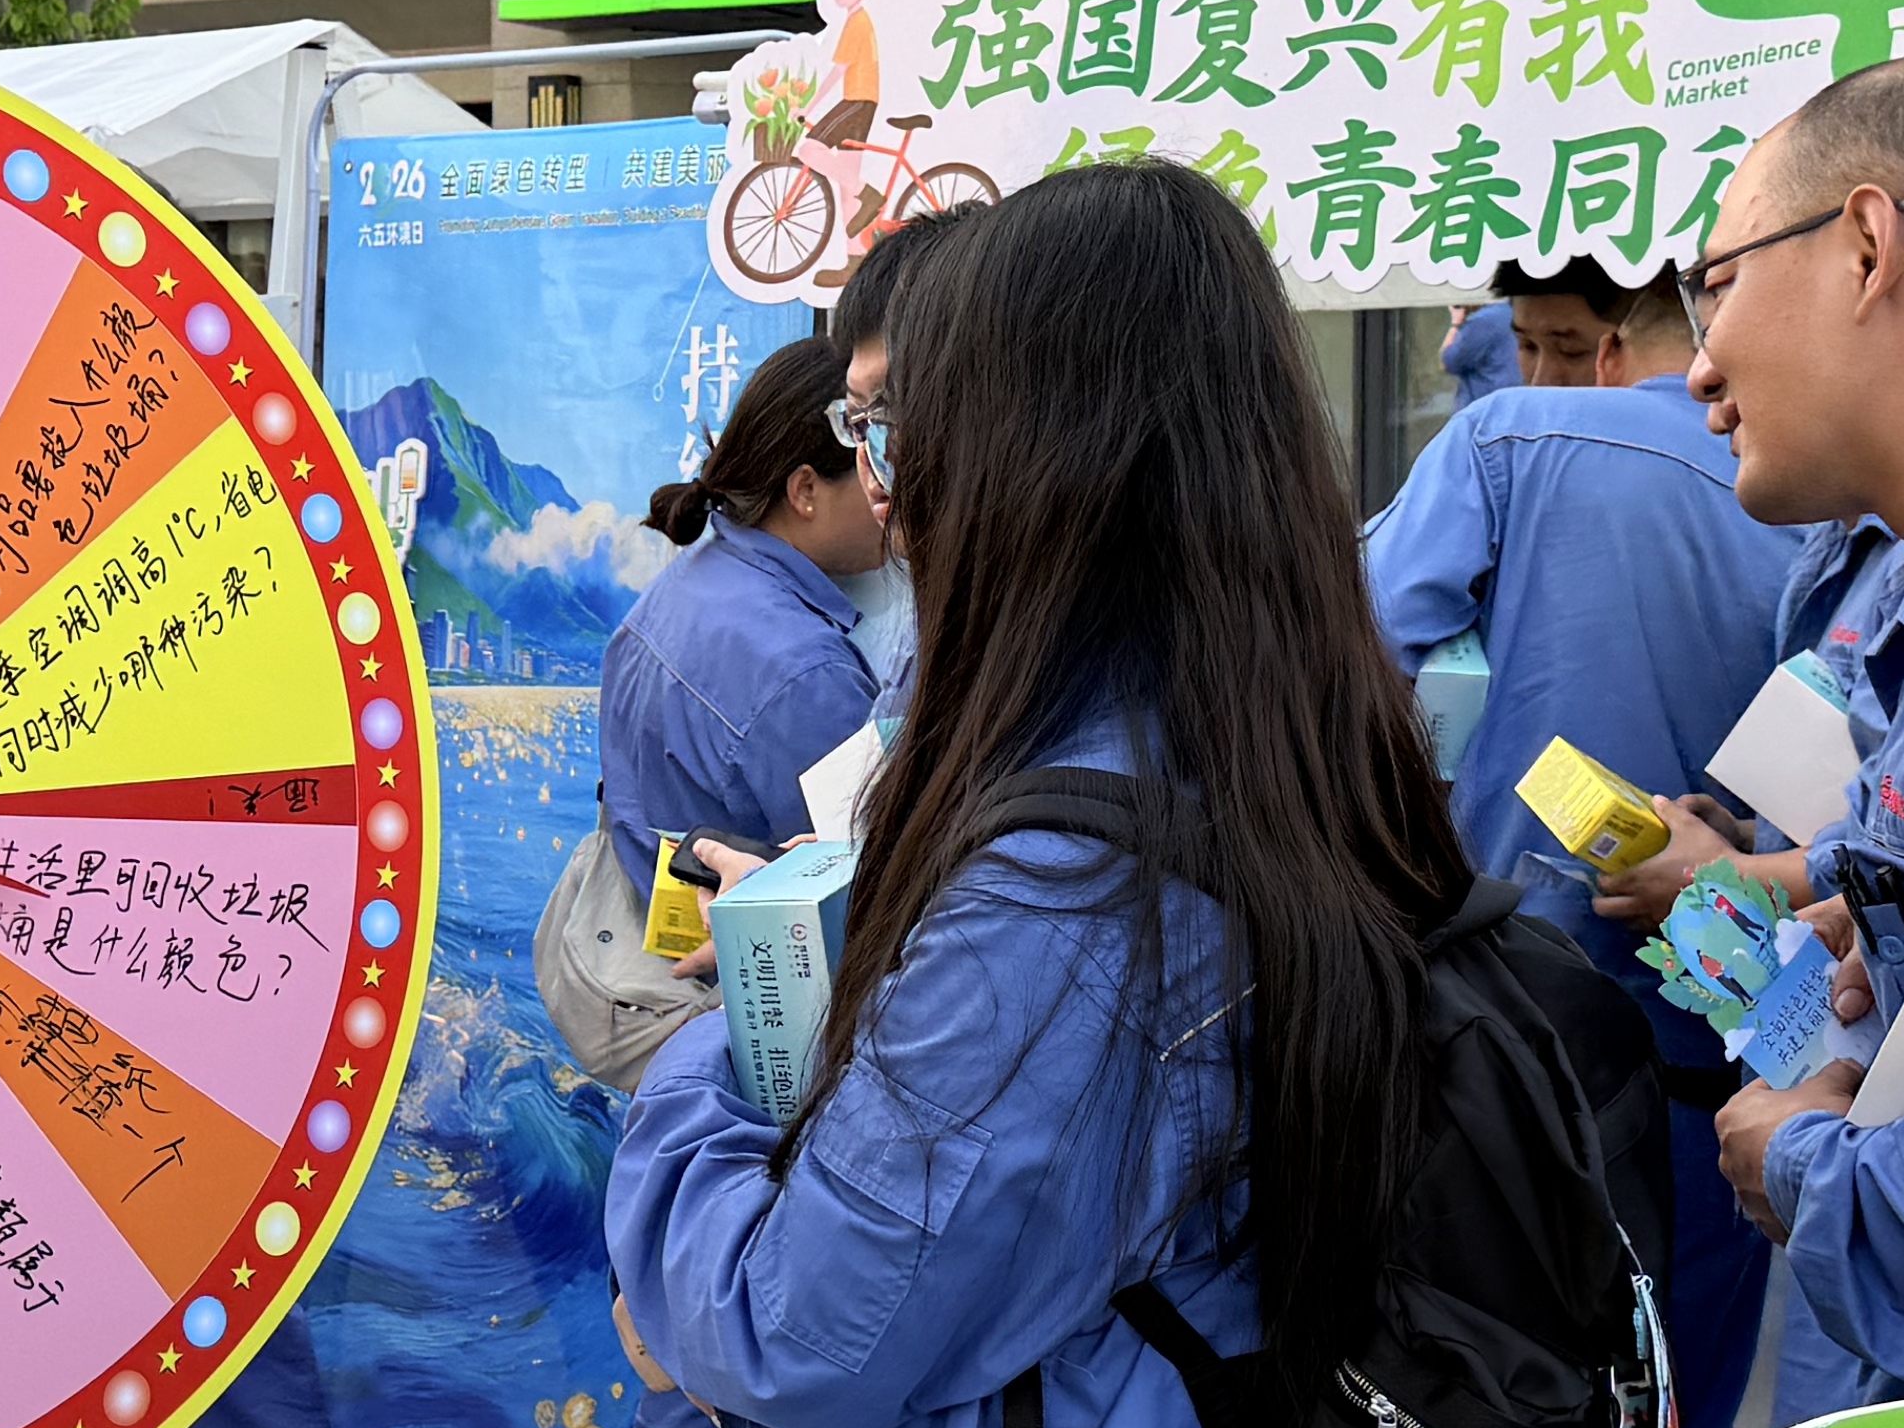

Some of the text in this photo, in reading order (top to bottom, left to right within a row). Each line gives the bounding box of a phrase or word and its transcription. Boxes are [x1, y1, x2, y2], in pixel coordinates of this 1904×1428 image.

[1666, 36, 1822, 83] Convenience
[1664, 75, 1749, 109] Market
[439, 152, 590, 201] 全面绿色转型
[1044, 118, 1758, 270] 青春同
[358, 221, 425, 249] 六五环境日
